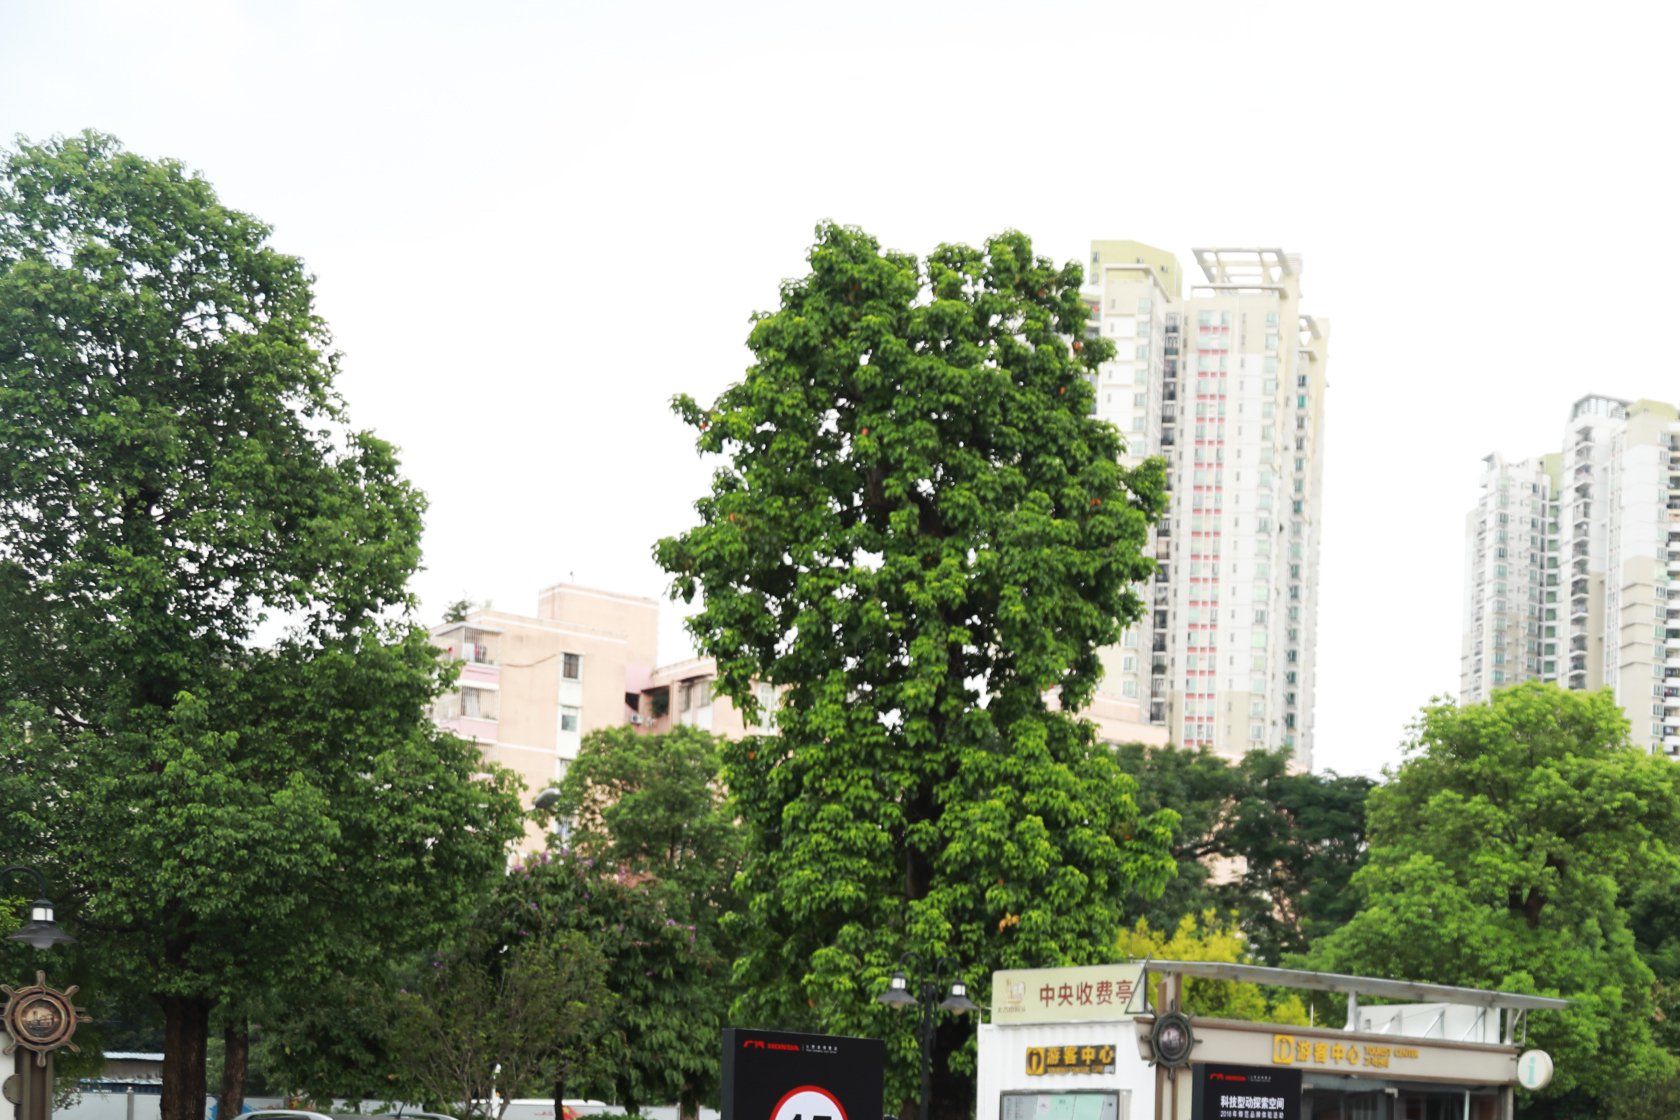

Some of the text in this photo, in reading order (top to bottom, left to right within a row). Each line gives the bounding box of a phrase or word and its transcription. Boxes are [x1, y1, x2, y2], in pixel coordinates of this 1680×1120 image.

[1039, 980, 1133, 1008] 中央收费亭
[767, 1043, 800, 1051] HONDA
[1046, 1045, 1114, 1065] 游客中心
[1296, 1041, 1360, 1065] 游客中心
[1220, 1095, 1285, 1110] 科技型动探索空间
